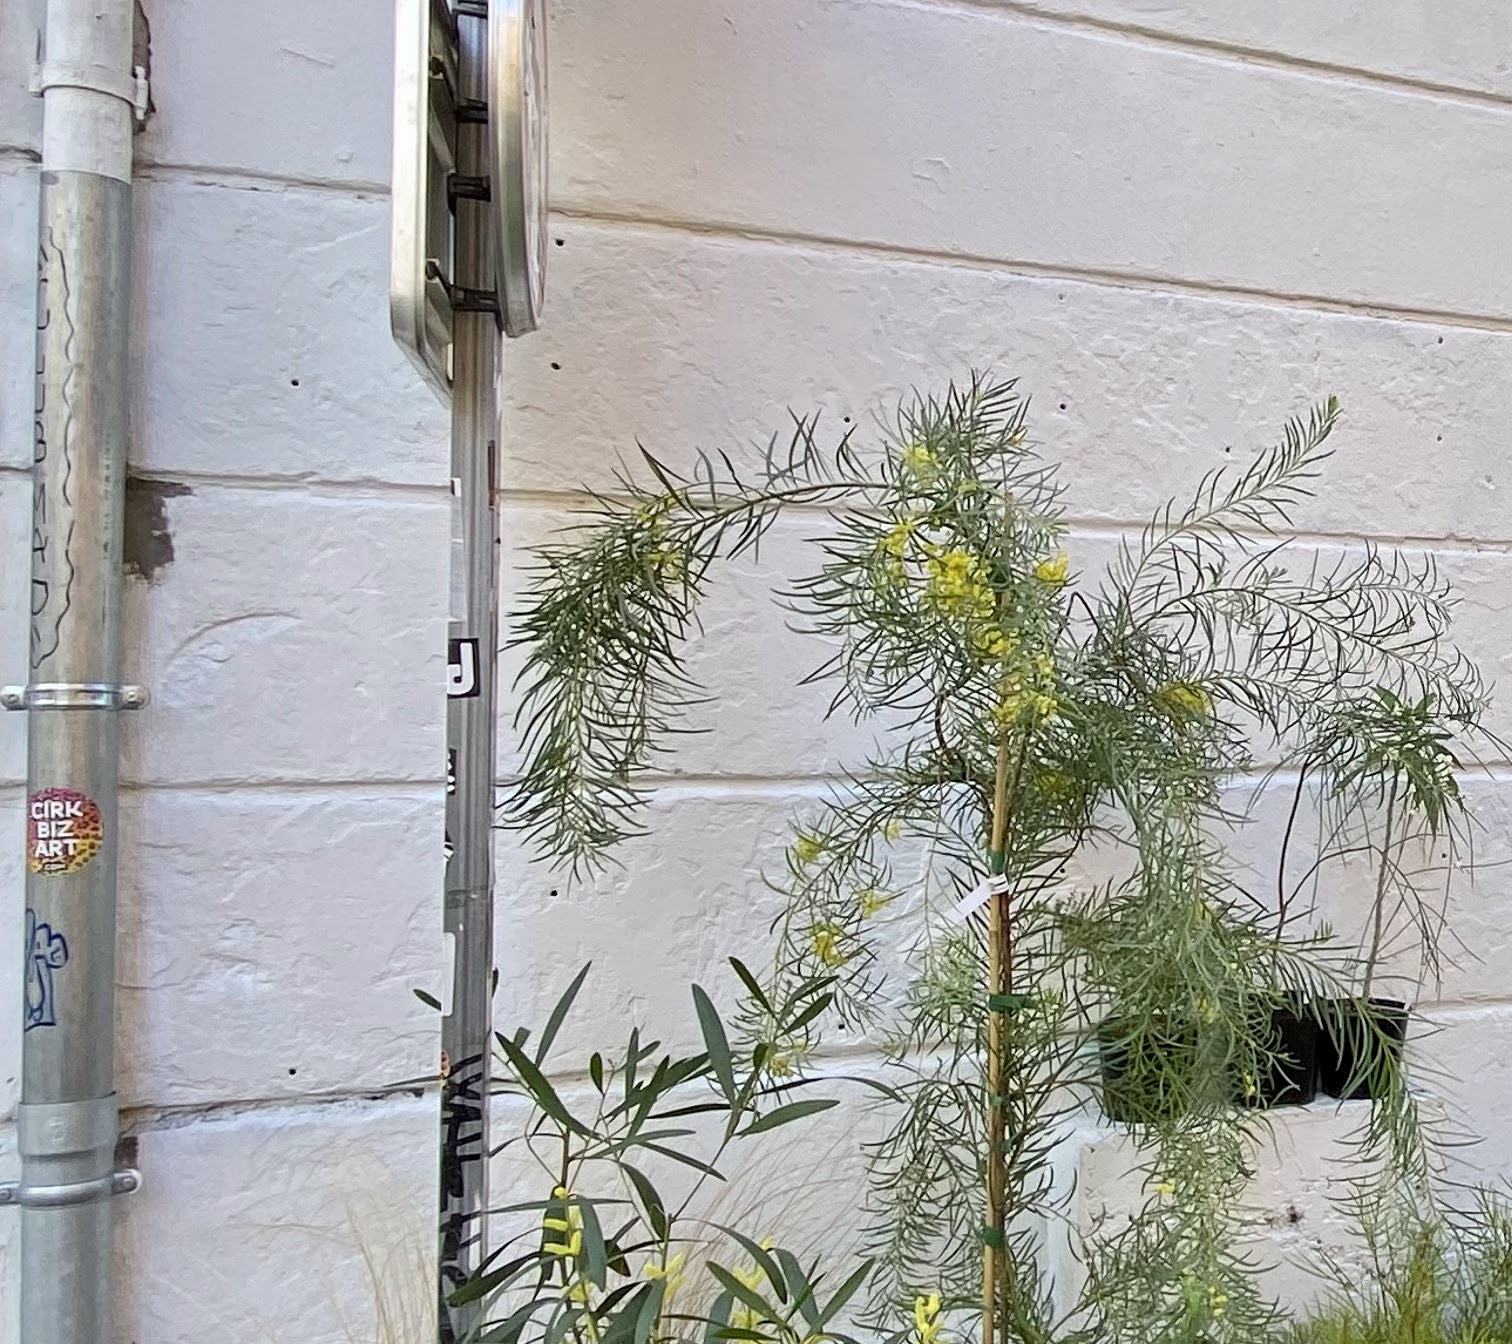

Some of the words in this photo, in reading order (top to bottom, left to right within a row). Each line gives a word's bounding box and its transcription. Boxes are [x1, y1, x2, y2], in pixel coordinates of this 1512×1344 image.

[31, 799, 84, 819] CIRK
[37, 820, 75, 838] BIZ
[34, 839, 80, 858] ART
